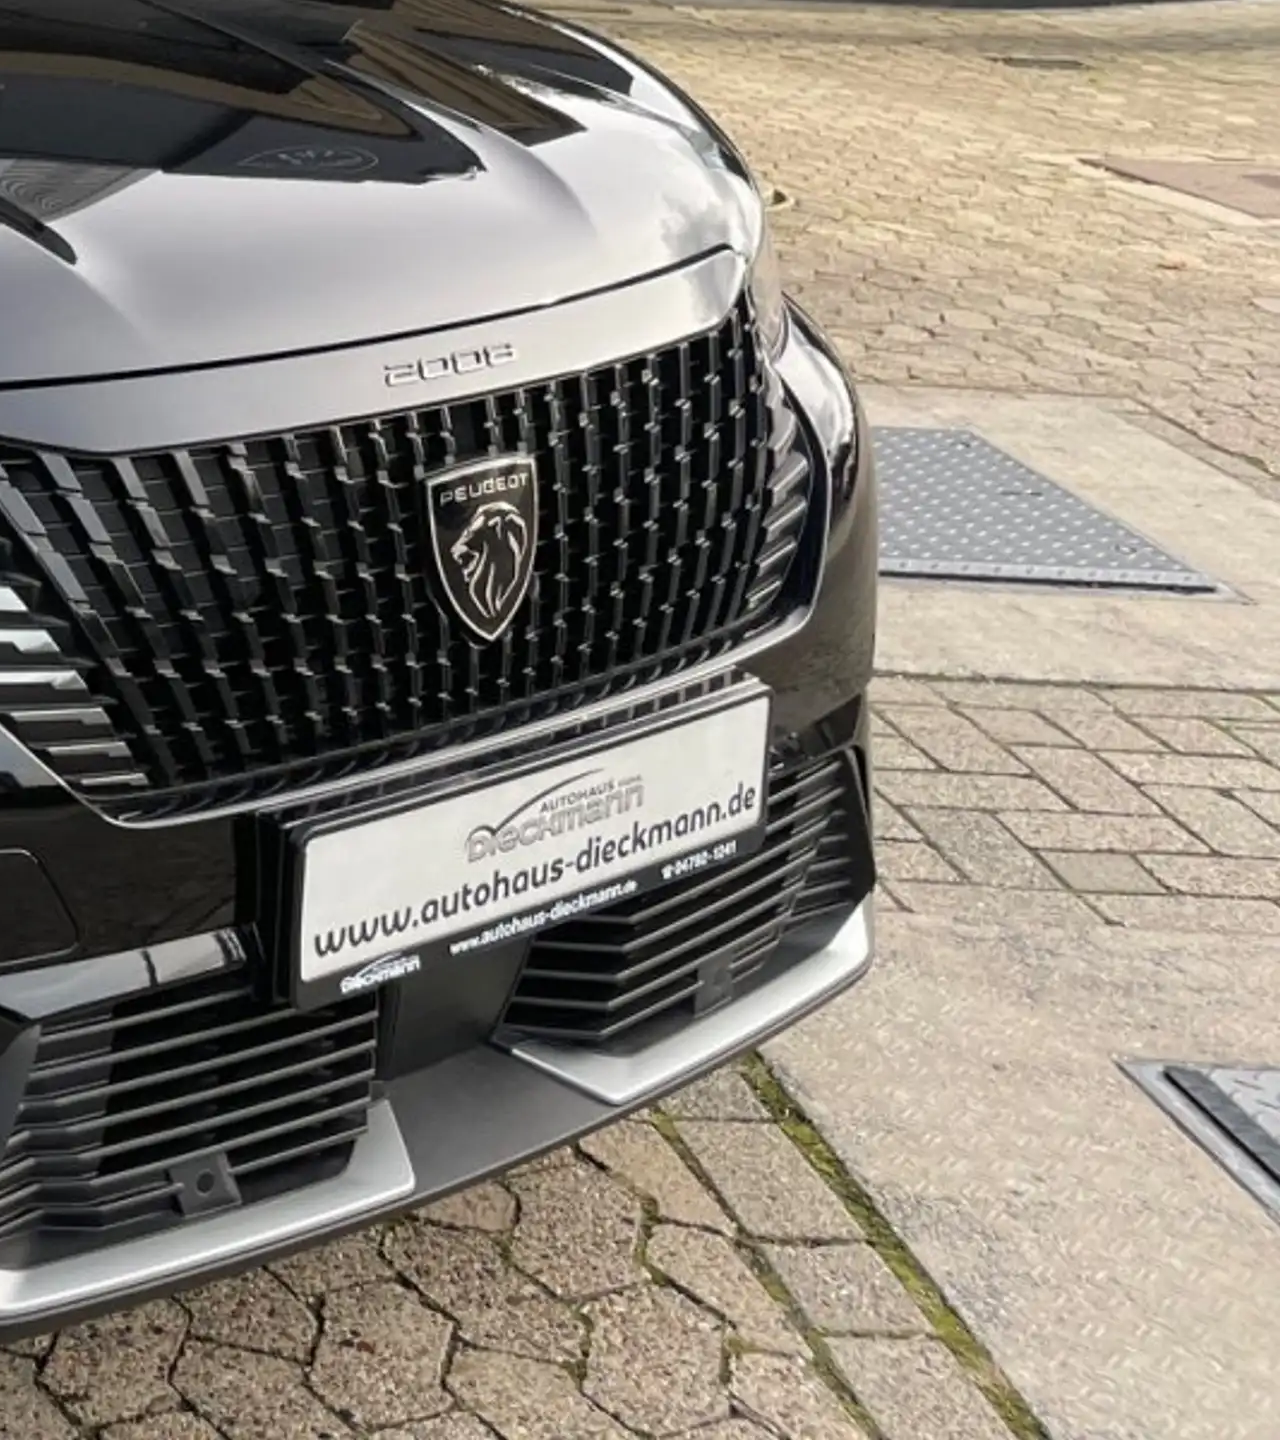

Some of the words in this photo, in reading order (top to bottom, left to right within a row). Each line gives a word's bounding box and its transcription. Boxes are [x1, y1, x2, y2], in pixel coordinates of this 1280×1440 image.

[440, 473, 528, 505] PEUGEOT
[541, 780, 615, 812] AUTOHAUS
[314, 782, 756, 957] www.autohaus-dieckmann.de
[449, 879, 639, 956] www.autohaus-dieckmann.de
